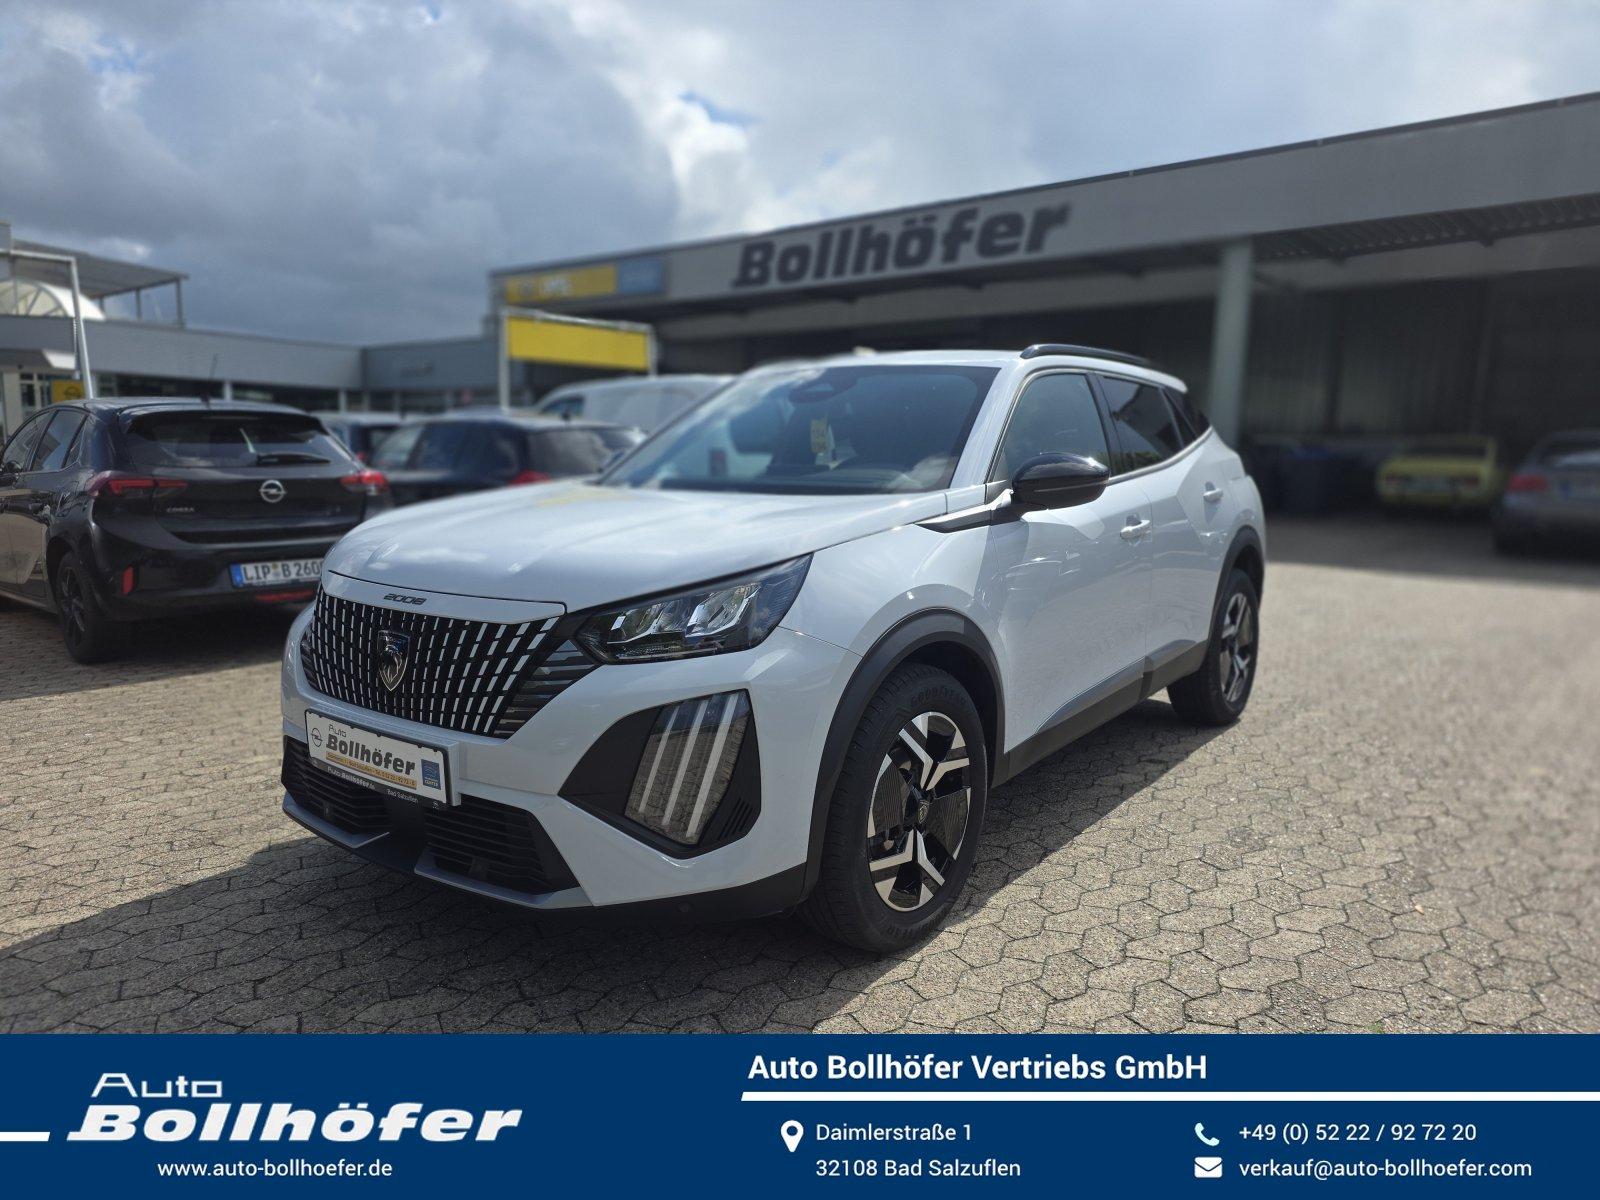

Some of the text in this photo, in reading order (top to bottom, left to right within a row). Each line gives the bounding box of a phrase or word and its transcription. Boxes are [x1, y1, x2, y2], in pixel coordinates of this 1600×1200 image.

[731, 202, 1073, 290] Bollhöfer
[242, 561, 324, 582] LIP B 260
[383, 592, 428, 606] 2008
[328, 724, 347, 738] Auto
[326, 733, 416, 776] Bollhöfer
